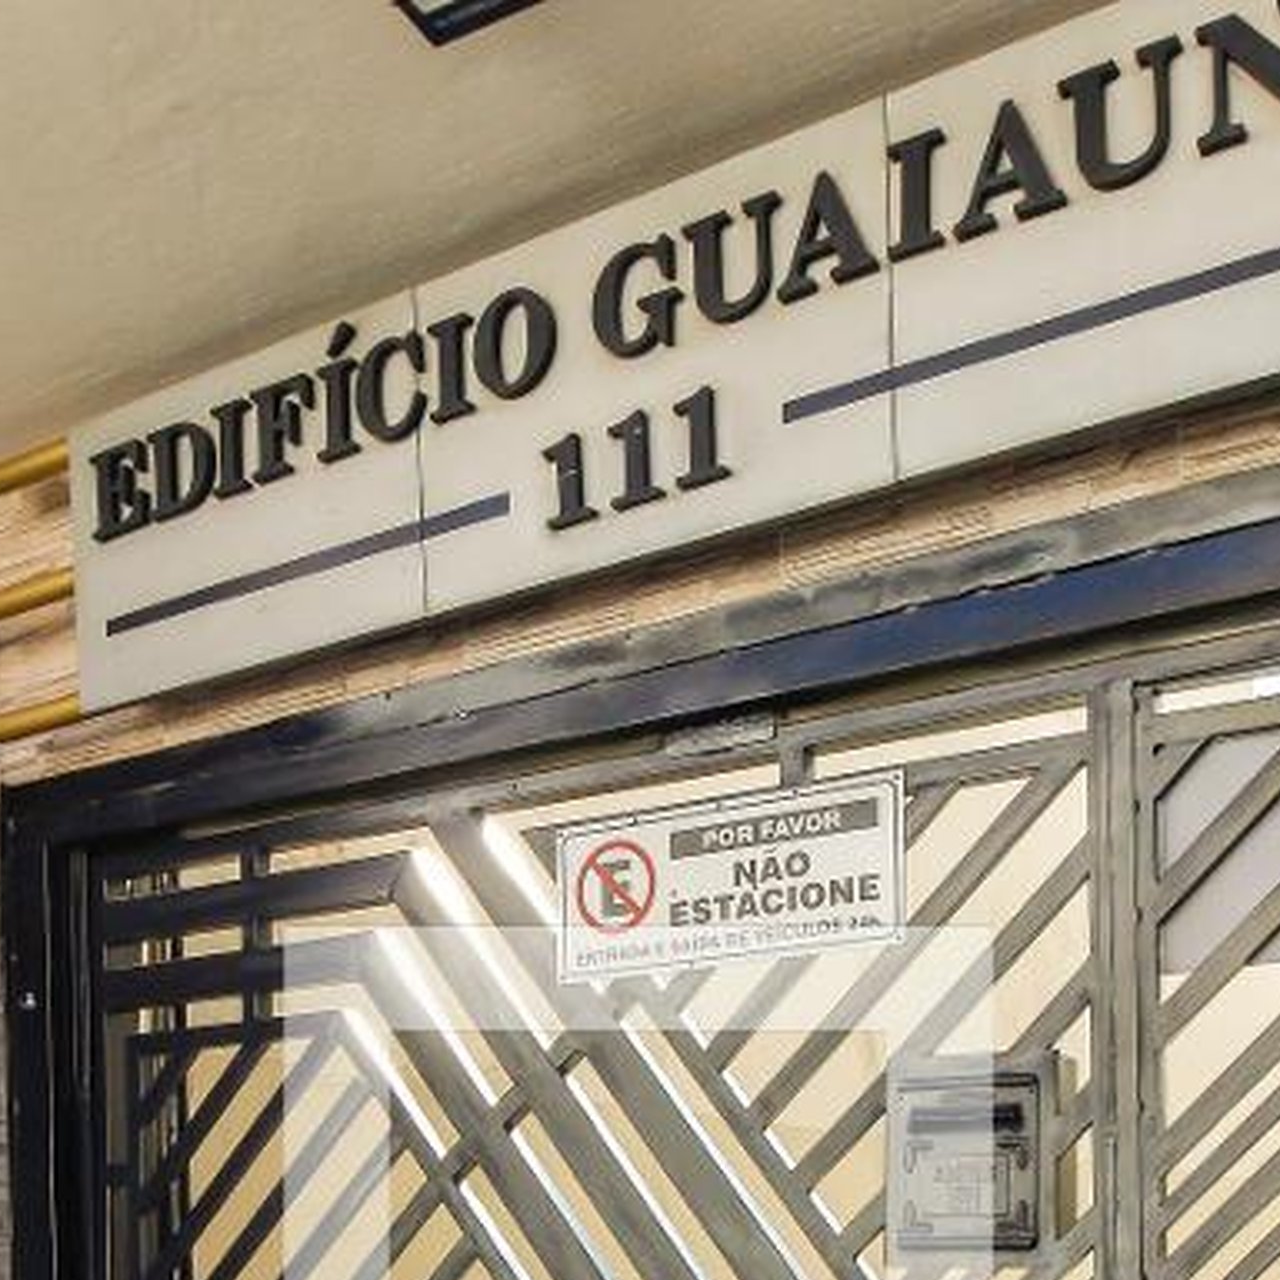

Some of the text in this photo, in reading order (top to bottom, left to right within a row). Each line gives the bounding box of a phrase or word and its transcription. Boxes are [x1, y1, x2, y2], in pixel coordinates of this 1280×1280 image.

[90, 287, 558, 543] EDIFÍCIO
[542, 386, 732, 532] 111
[702, 808, 843, 850] POR FAVOR
[732, 847, 811, 888] NÃO
[669, 873, 881, 928] ESTACIONE
[726, 930, 751, 950] DE
